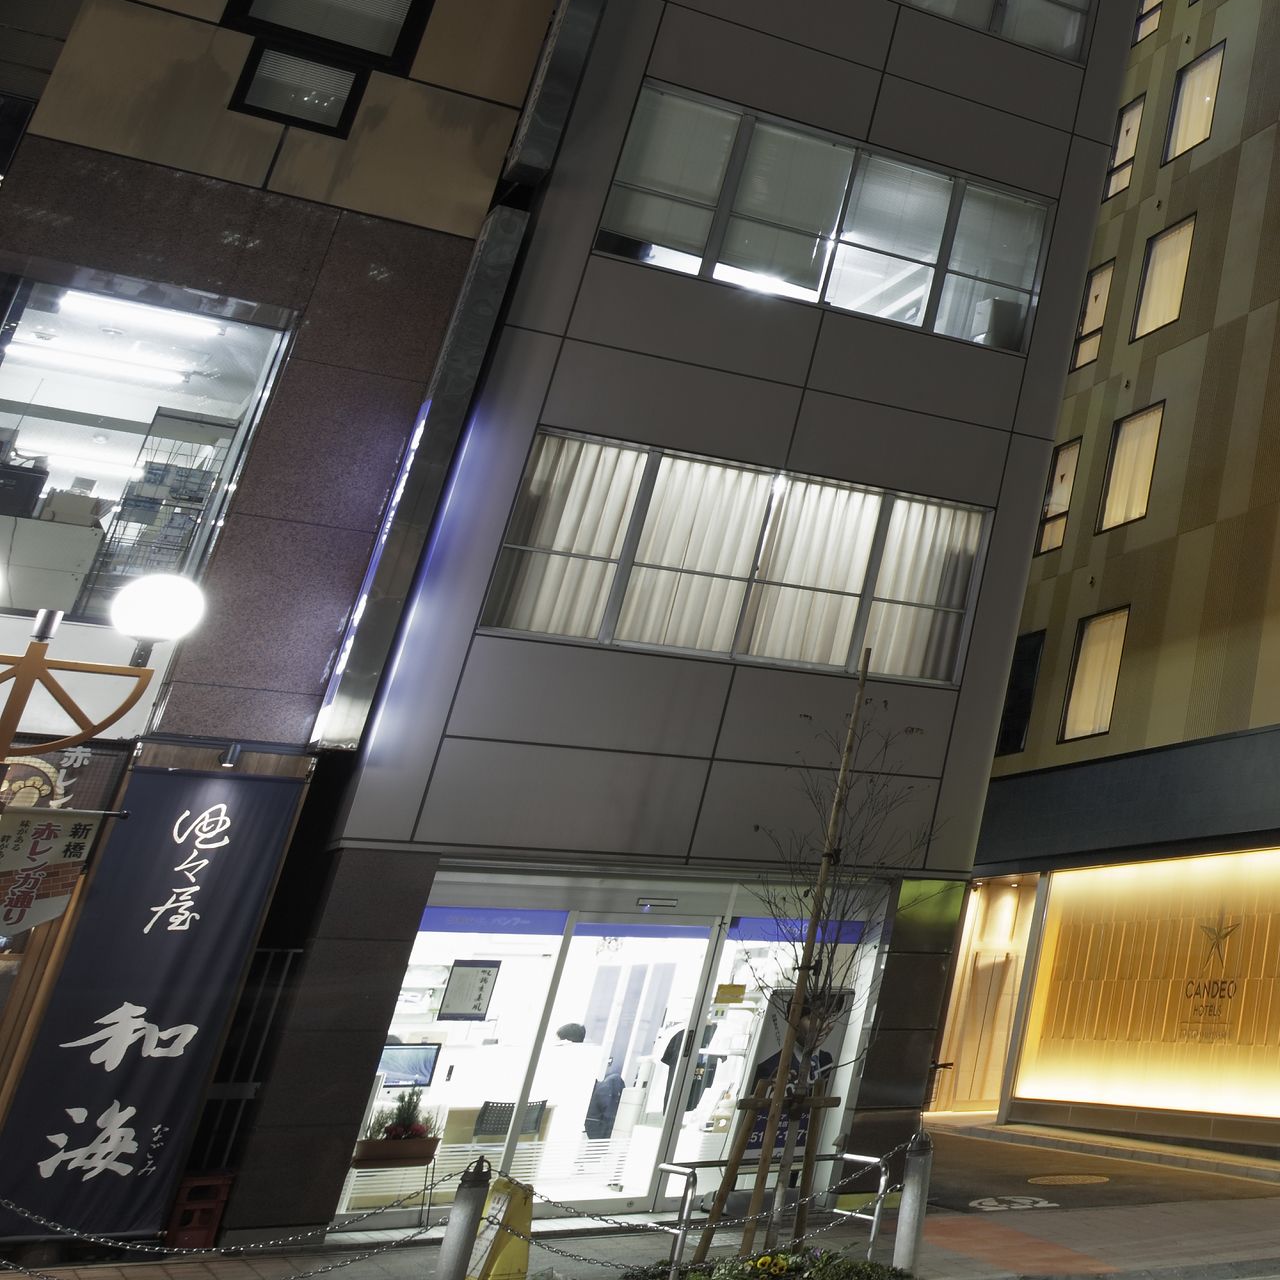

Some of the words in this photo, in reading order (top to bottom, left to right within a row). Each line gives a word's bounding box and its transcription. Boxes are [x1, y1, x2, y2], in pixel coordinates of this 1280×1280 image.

[4, 822, 62, 926] 赤レンガ通り
[62, 822, 94, 859] 新橋
[1185, 980, 1237, 1000] CANDEO
[37, 1001, 199, 1182] 和海
